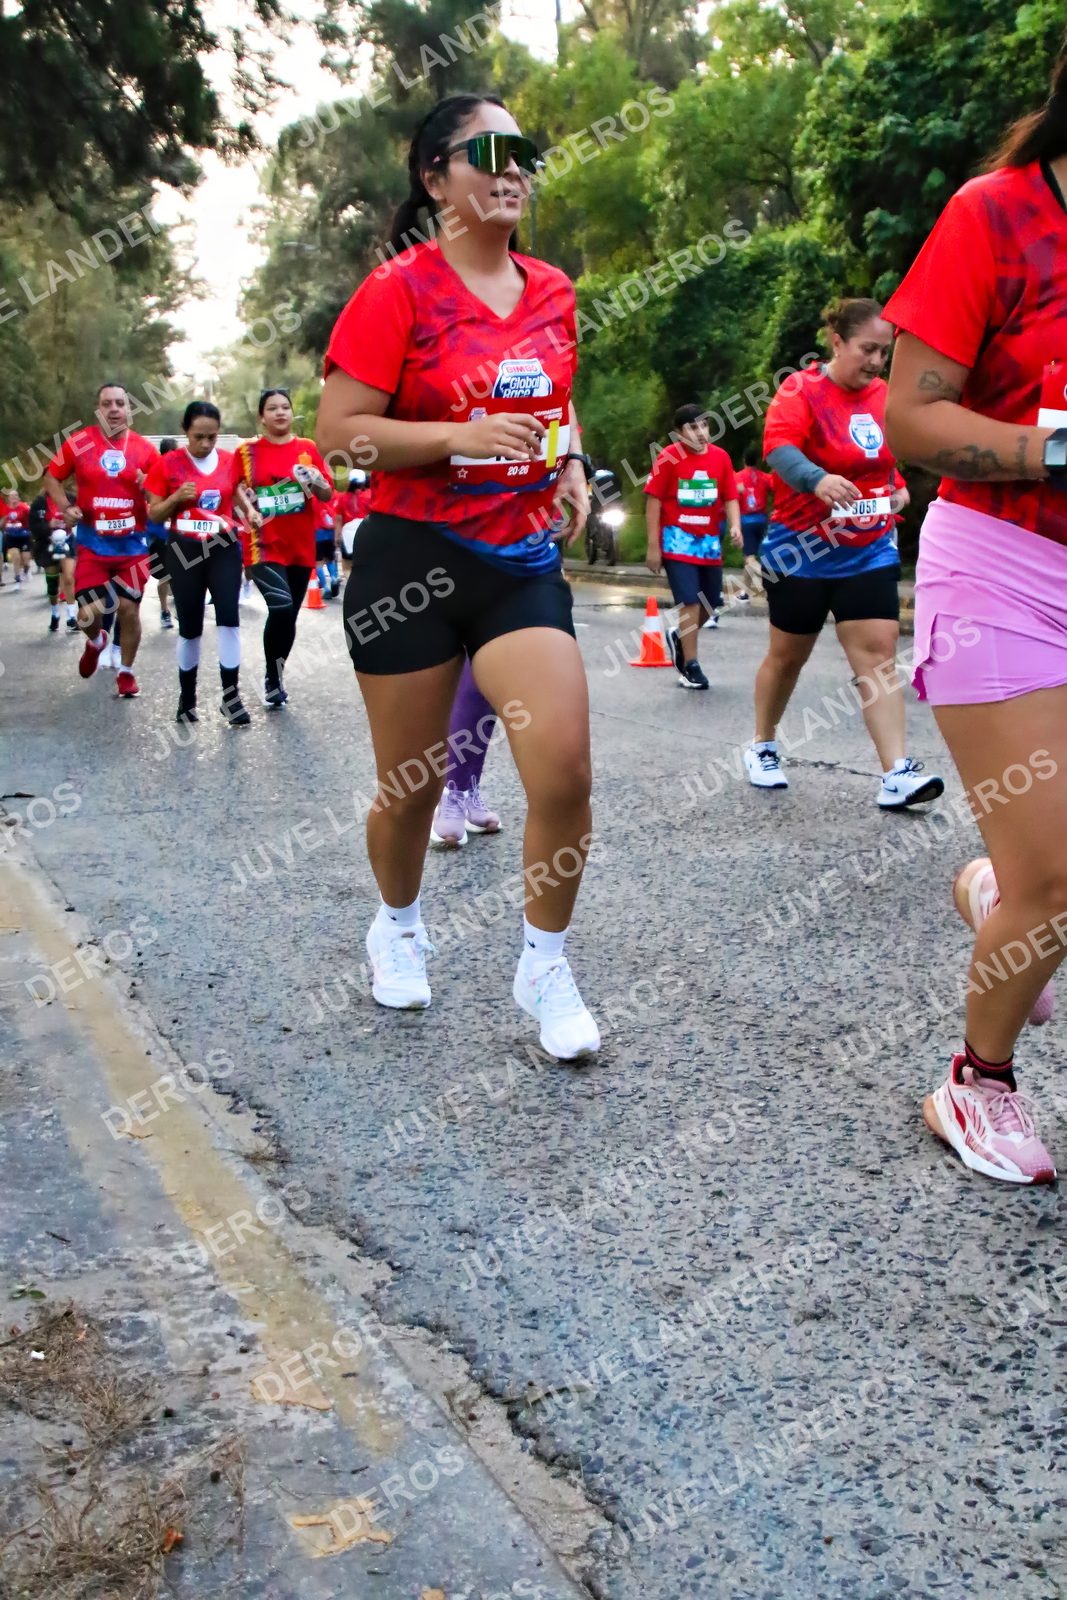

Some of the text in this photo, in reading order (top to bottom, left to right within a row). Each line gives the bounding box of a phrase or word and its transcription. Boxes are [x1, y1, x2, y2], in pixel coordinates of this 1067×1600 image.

[509, 375, 540, 390] Global
[92, 495, 135, 510] SANTIAGO
[106, 519, 128, 530] 2334
[192, 520, 214, 532] 1407
